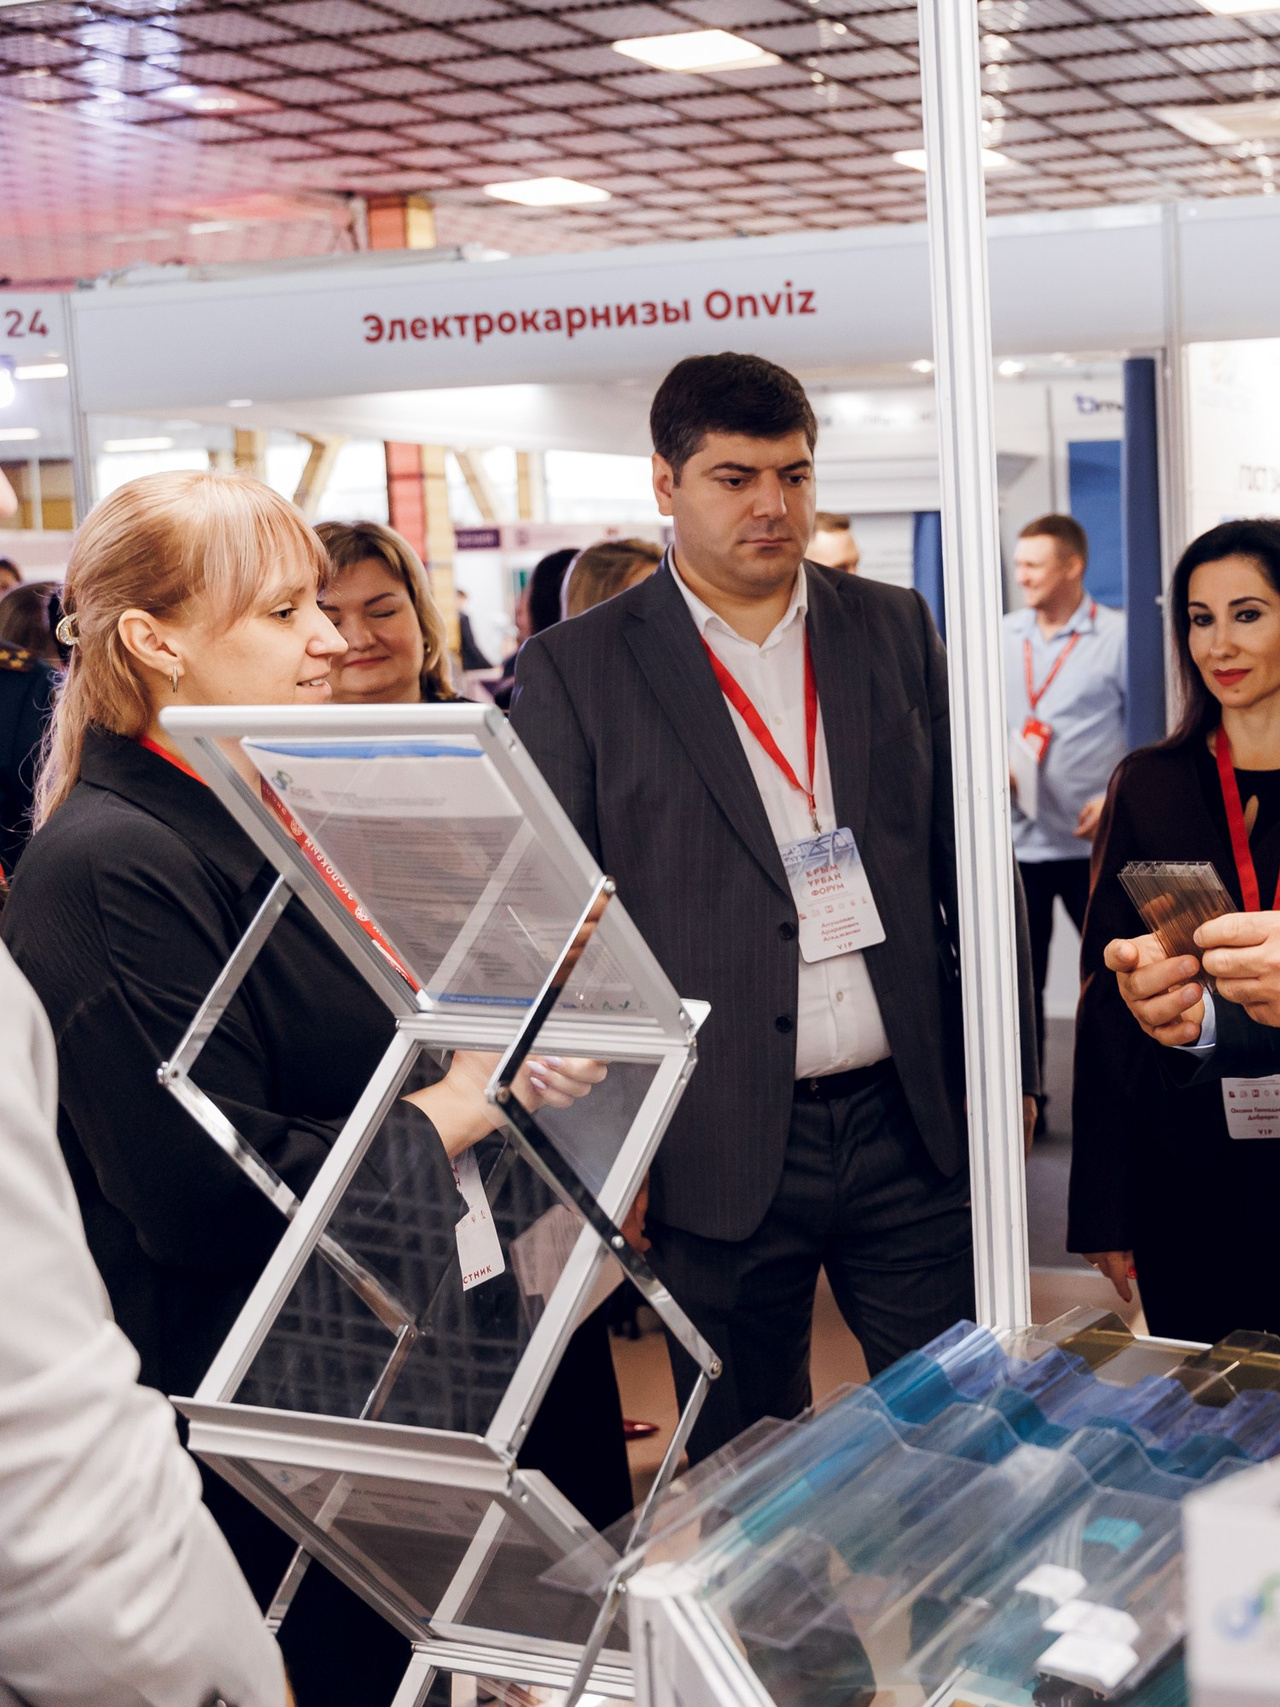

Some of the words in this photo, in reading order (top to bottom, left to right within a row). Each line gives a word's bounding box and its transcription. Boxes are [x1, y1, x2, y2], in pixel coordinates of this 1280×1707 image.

[362, 299, 691, 344] Электрокарнизы
[704, 281, 816, 321] Onviz
[5, 309, 49, 338] 24
[304, 837, 355, 900] ЭКСПОКРЫМ
[805, 864, 839, 878] КРЫМ
[807, 872, 842, 888] УРБАН
[811, 883, 845, 896] ФОРУМ
[837, 941, 853, 950] VIP
